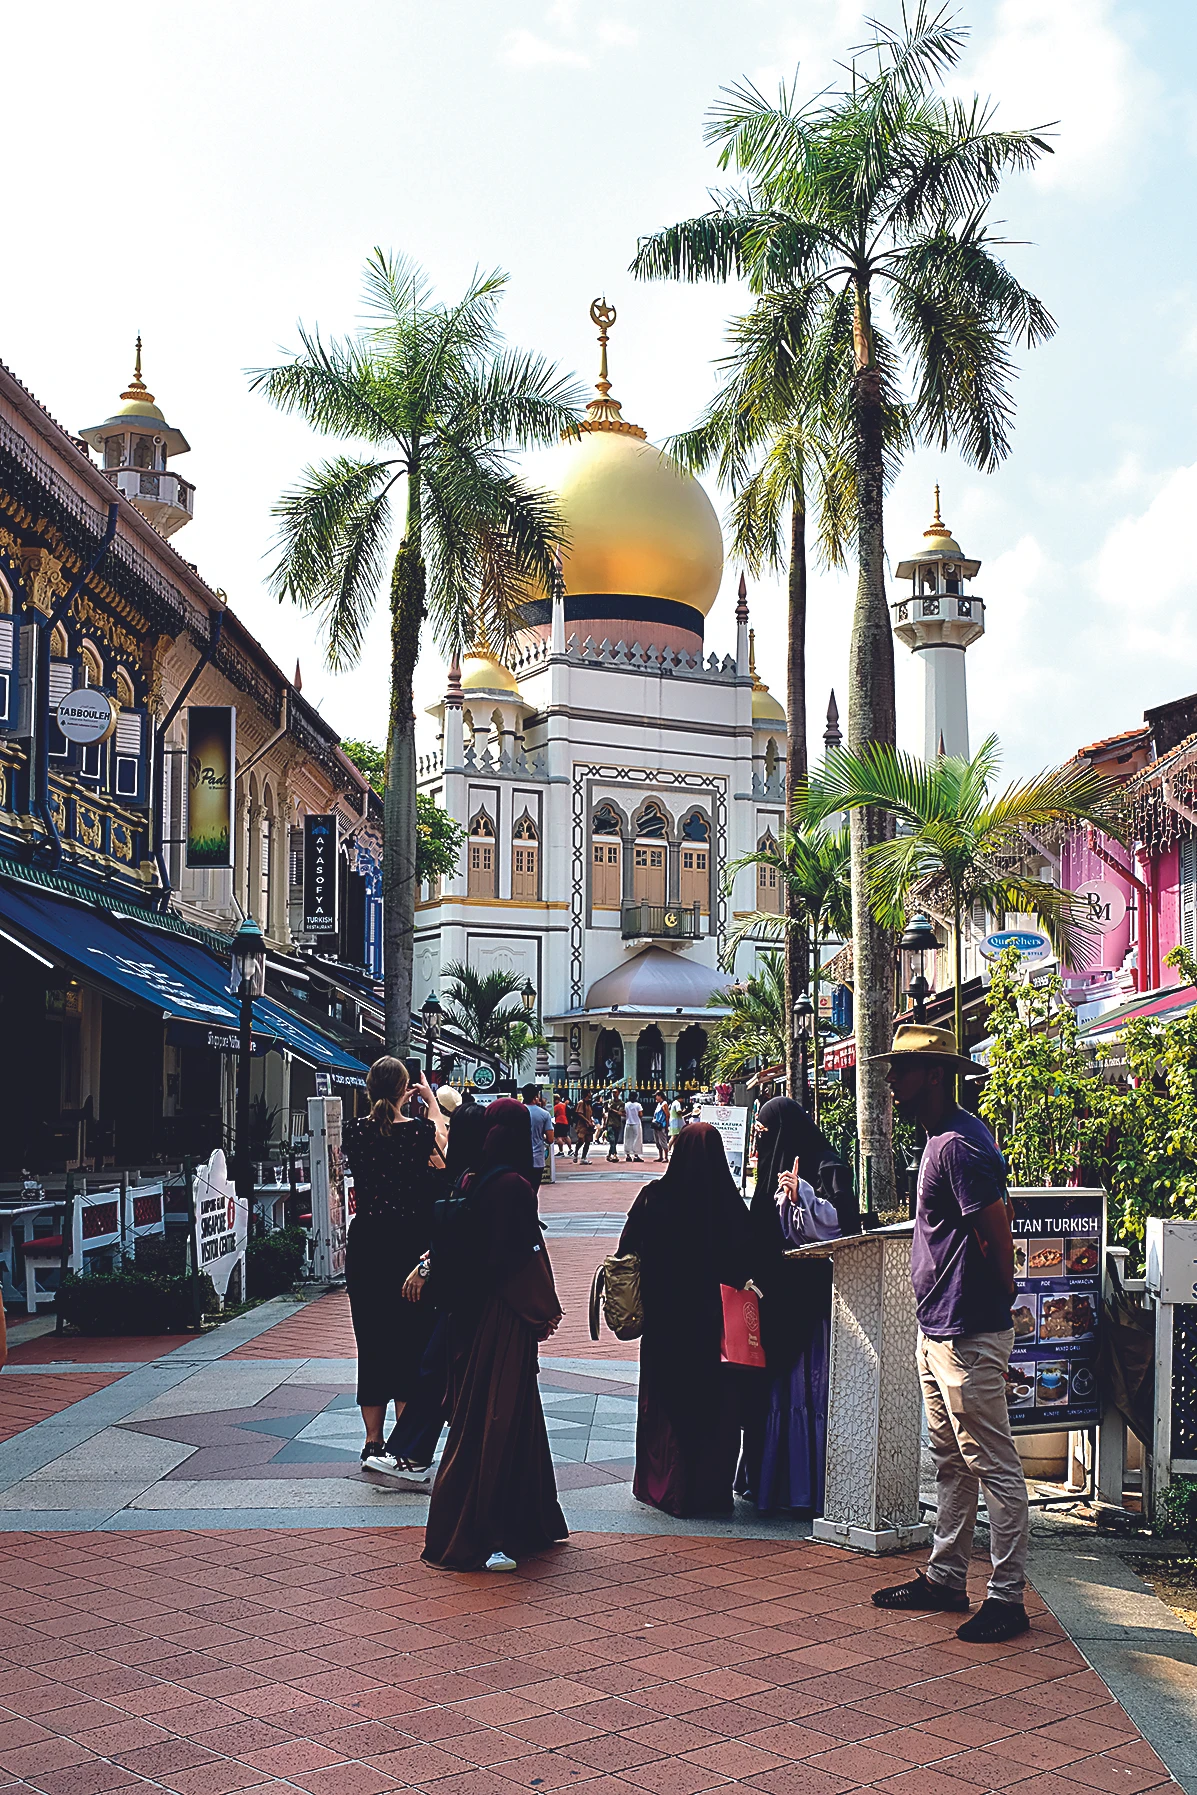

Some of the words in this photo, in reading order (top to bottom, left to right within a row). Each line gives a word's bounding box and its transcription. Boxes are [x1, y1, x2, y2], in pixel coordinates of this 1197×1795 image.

[60, 707, 110, 720] TABBOULEH
[316, 837, 324, 913] AYASOFYA
[1011, 1219, 1042, 1233] LTAN
[1045, 1217, 1099, 1232] TURKISH
